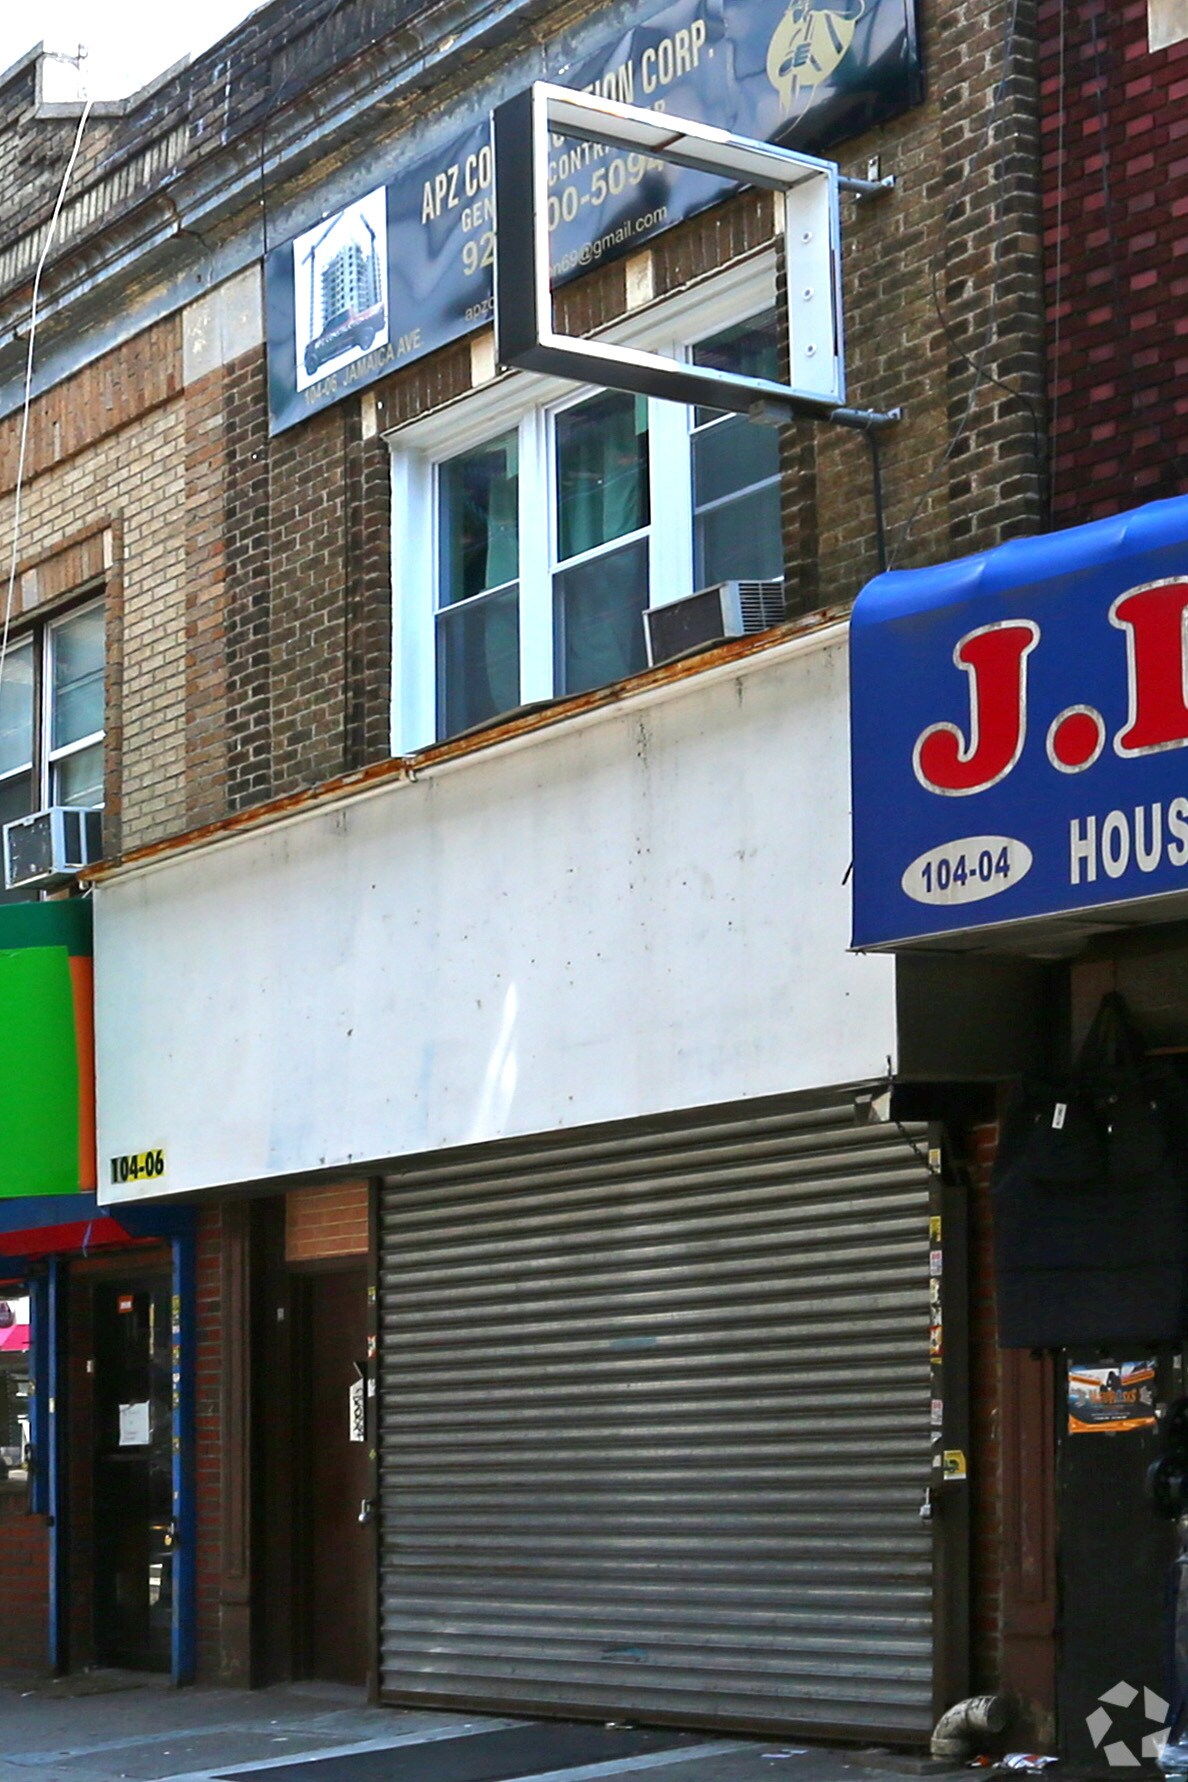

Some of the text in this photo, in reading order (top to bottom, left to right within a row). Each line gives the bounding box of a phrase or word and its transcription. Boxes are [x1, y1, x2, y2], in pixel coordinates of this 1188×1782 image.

[421, 163, 460, 225] APZ
[642, 18, 715, 95] CORP.
[342, 342, 396, 387] JAMAICA
[396, 327, 421, 359] AVE
[920, 845, 1012, 894] 104-04
[1069, 796, 1188, 885] HOUS
[110, 1148, 165, 1185] 104-06
